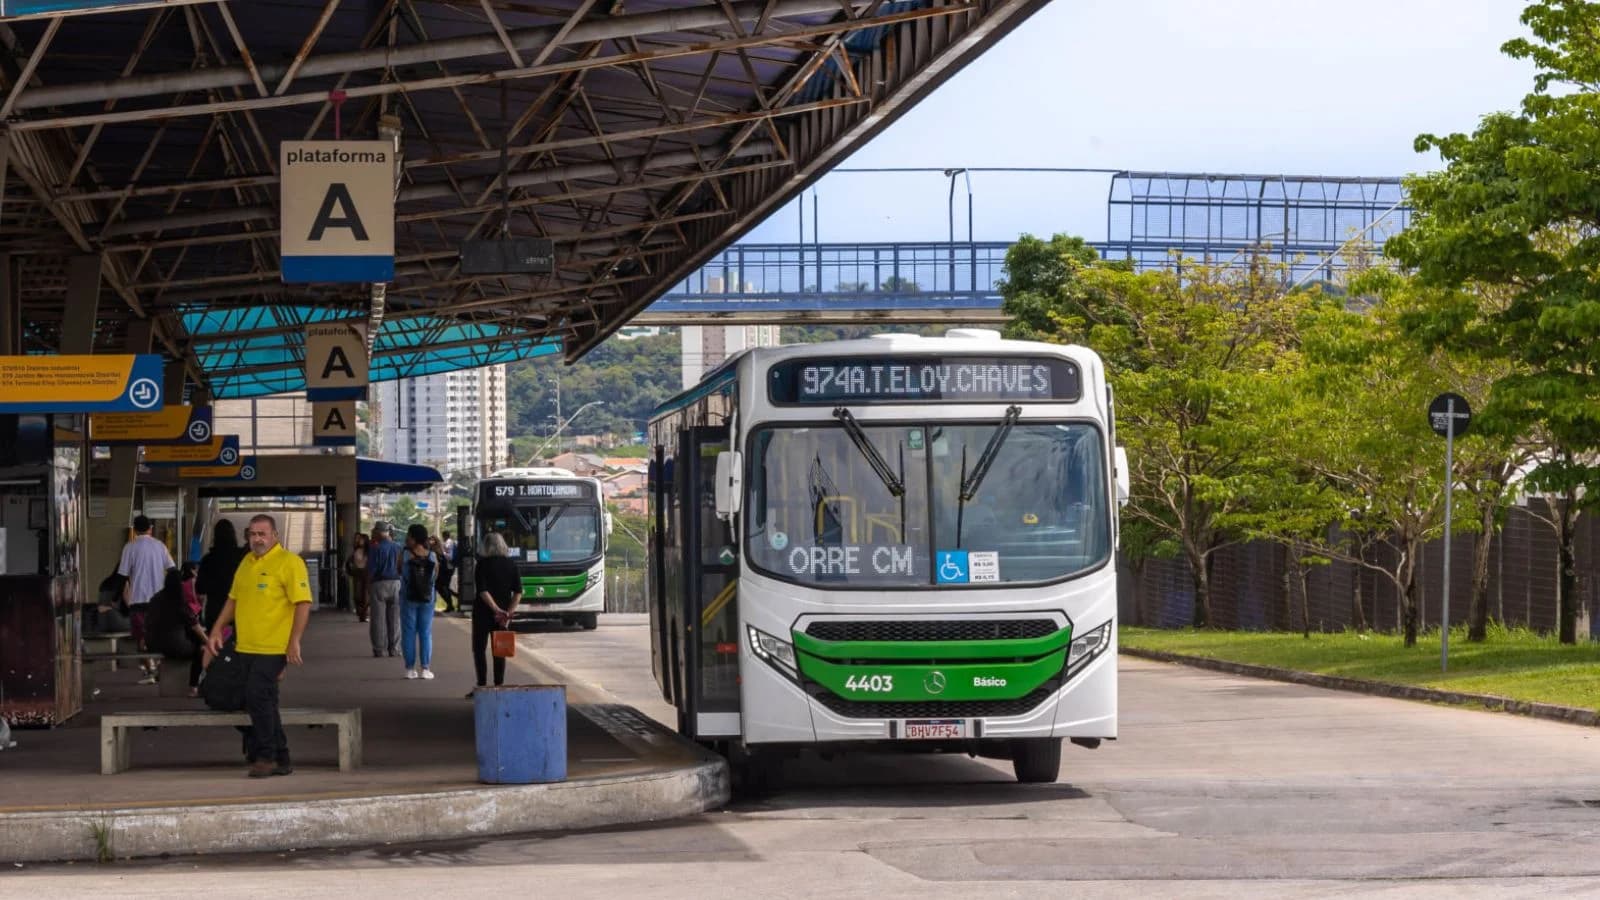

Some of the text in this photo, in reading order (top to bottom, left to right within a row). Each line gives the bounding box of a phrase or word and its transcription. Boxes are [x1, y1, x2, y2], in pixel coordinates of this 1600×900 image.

[287, 148, 386, 165] plataforma
[307, 183, 370, 241] A
[308, 327, 358, 337] platafor
[321, 346, 356, 379] A
[323, 408, 346, 430] A
[495, 486, 515, 496] 579
[788, 547, 913, 576] ORRE CM
[845, 675, 1007, 692] 4403 Básico
[911, 726, 959, 737] BHV7F54
